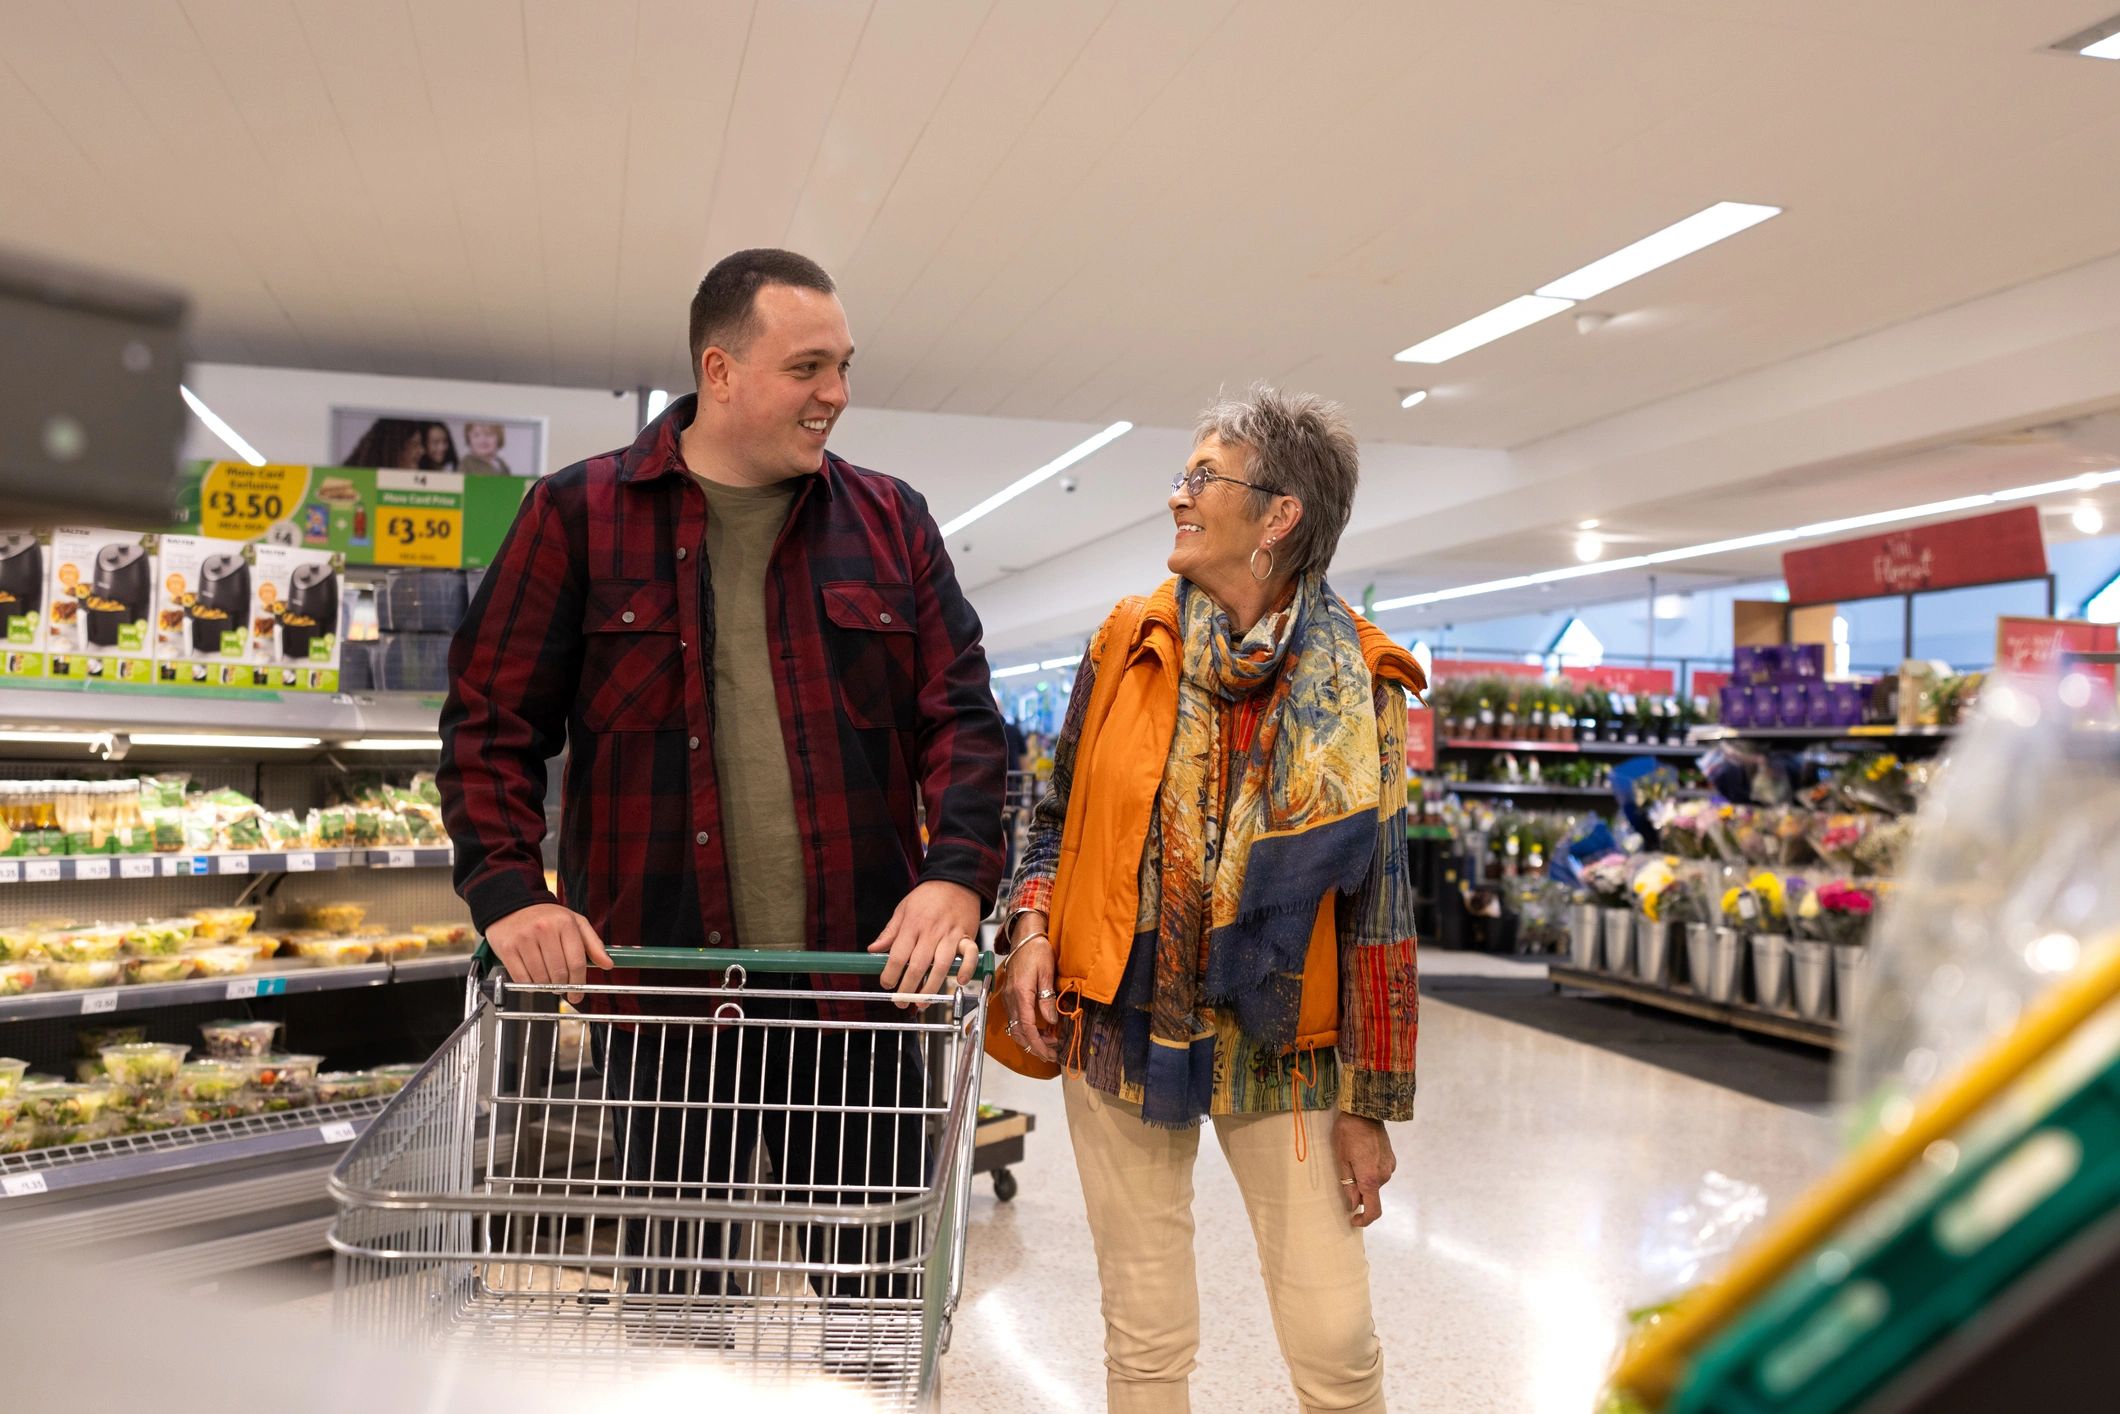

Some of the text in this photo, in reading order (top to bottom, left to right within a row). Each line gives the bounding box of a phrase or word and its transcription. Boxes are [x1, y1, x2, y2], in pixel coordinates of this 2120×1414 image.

[226, 467, 286, 480] More Card
[230, 480, 280, 491] Exclusive
[209, 490, 283, 520] £3.50
[383, 492, 456, 506] More Card Price
[60, 527, 91, 536] SALTER
[387, 516, 452, 545] £3.50
[274, 531, 293, 546] £4
